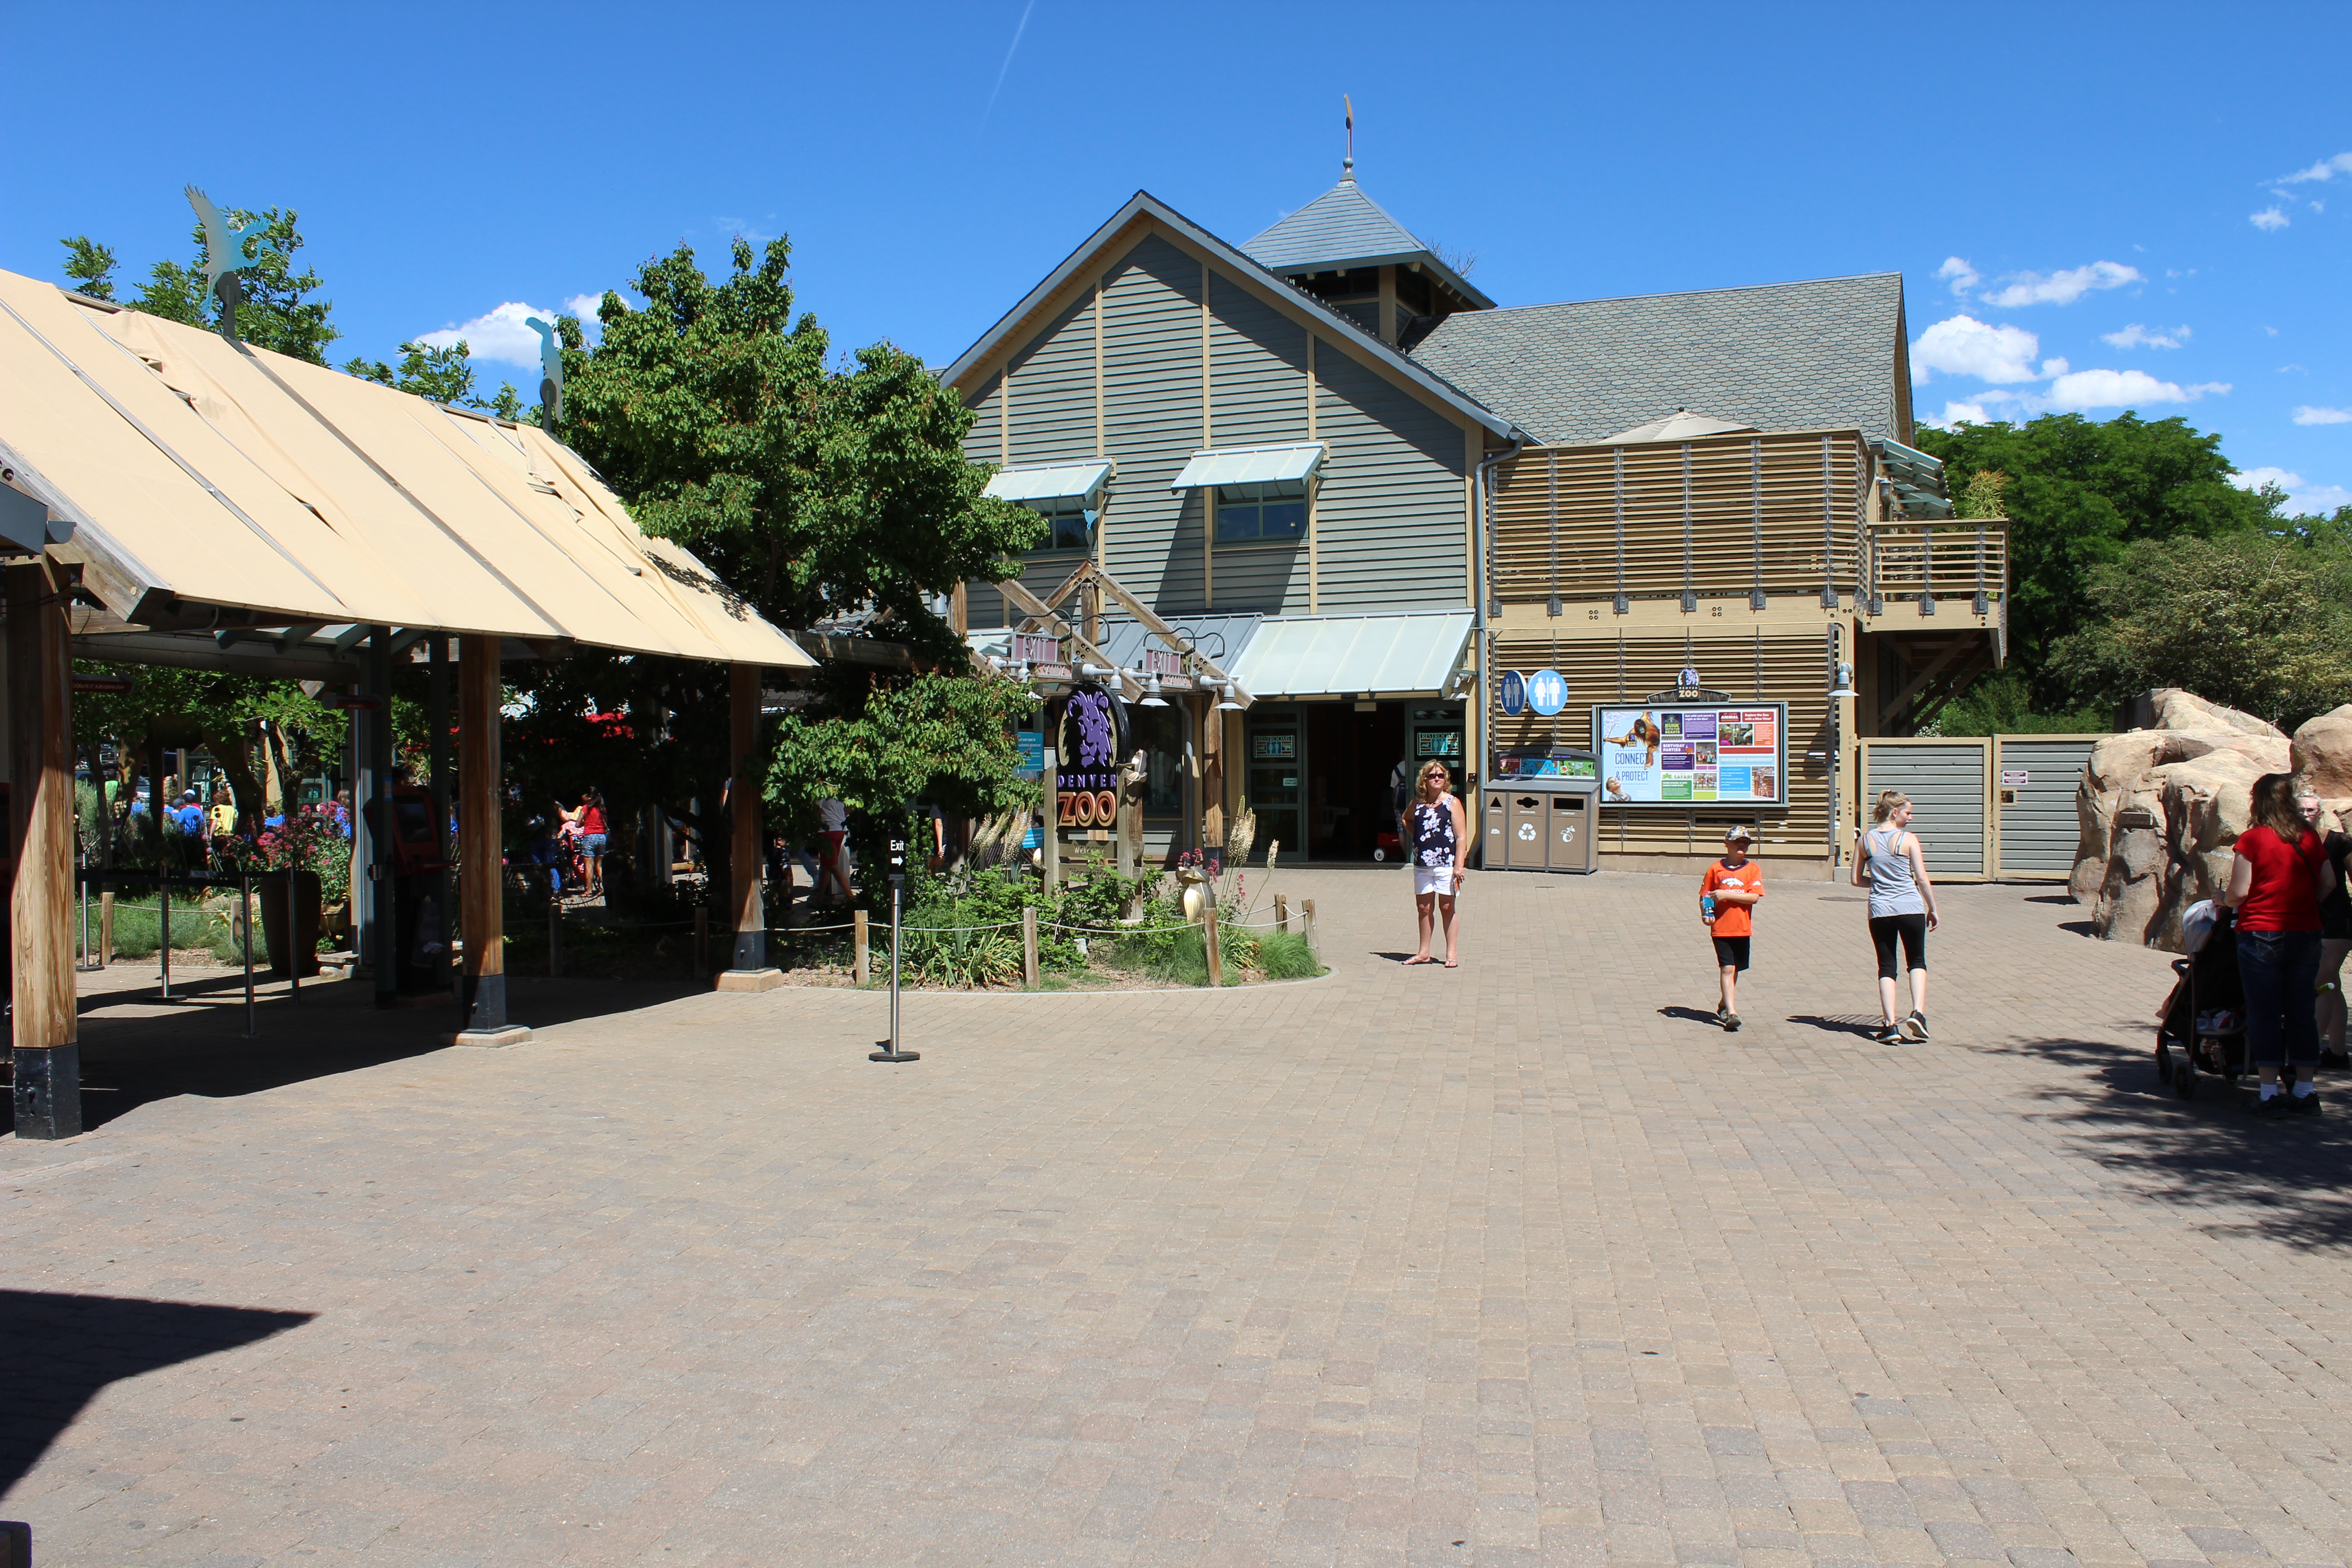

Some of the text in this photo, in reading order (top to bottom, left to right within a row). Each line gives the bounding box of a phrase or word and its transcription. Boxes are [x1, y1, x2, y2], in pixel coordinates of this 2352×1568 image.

[1023, 636, 1049, 661] EXIT
[1152, 650, 1173, 672] EXIT
[1615, 753, 1649, 764] CONNECT
[1058, 774, 1116, 788] DENVER
[1615, 771, 1649, 781] & PROTECT
[1058, 791, 1116, 827] ZOO
[890, 840, 904, 851] Exit
